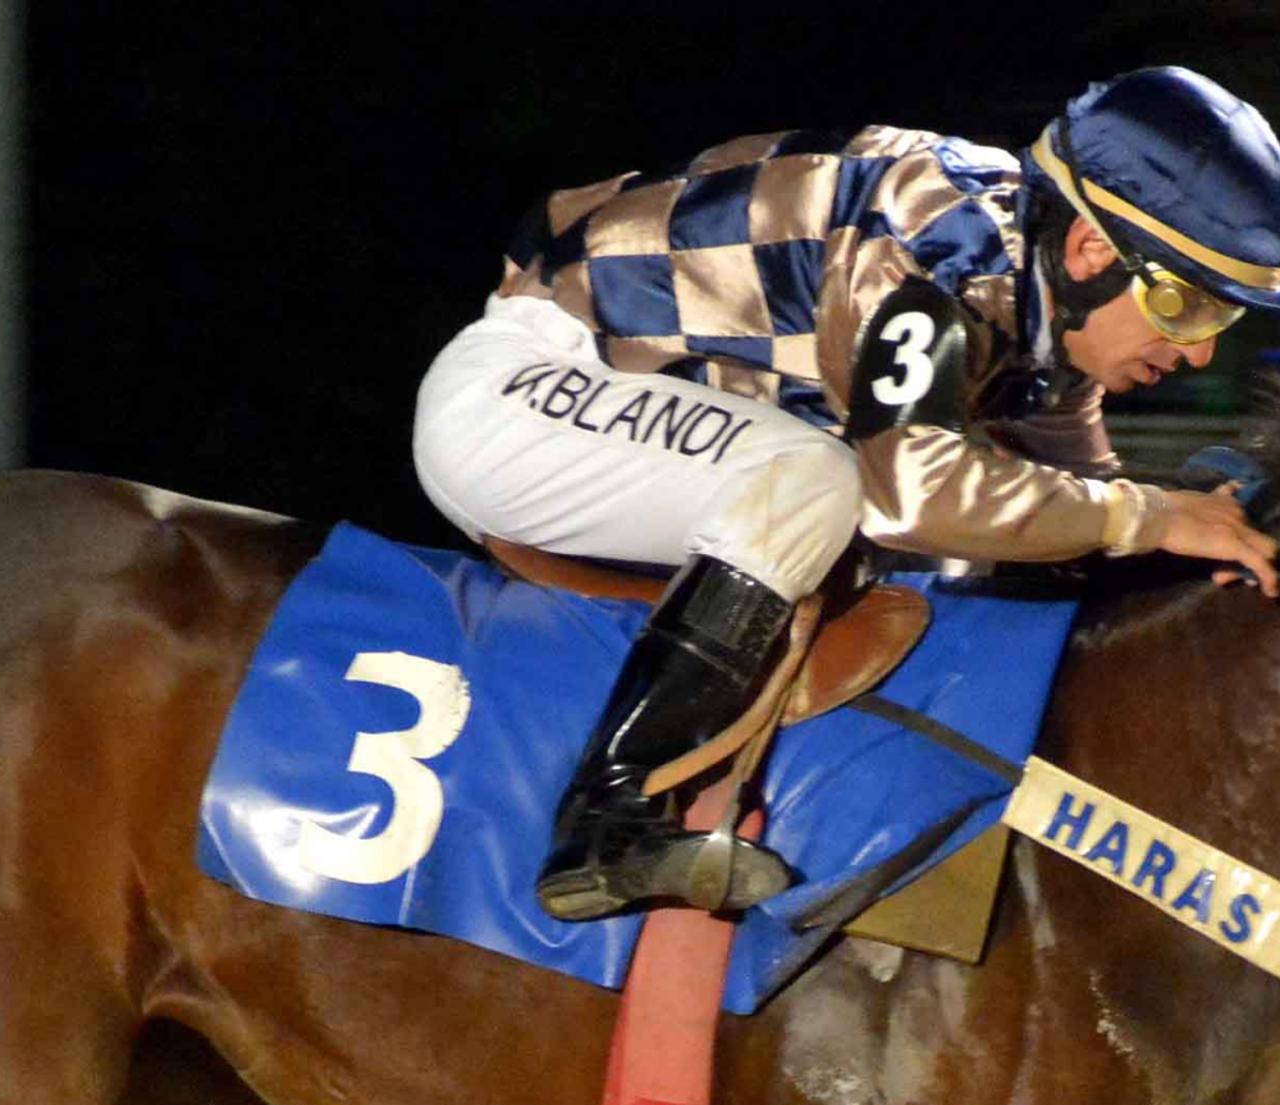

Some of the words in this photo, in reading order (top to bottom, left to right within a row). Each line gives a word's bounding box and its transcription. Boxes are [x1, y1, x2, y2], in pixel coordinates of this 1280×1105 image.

[871, 311, 935, 405] 3
[297, 651, 471, 884] 3
[1044, 792, 1262, 944] HARAS
